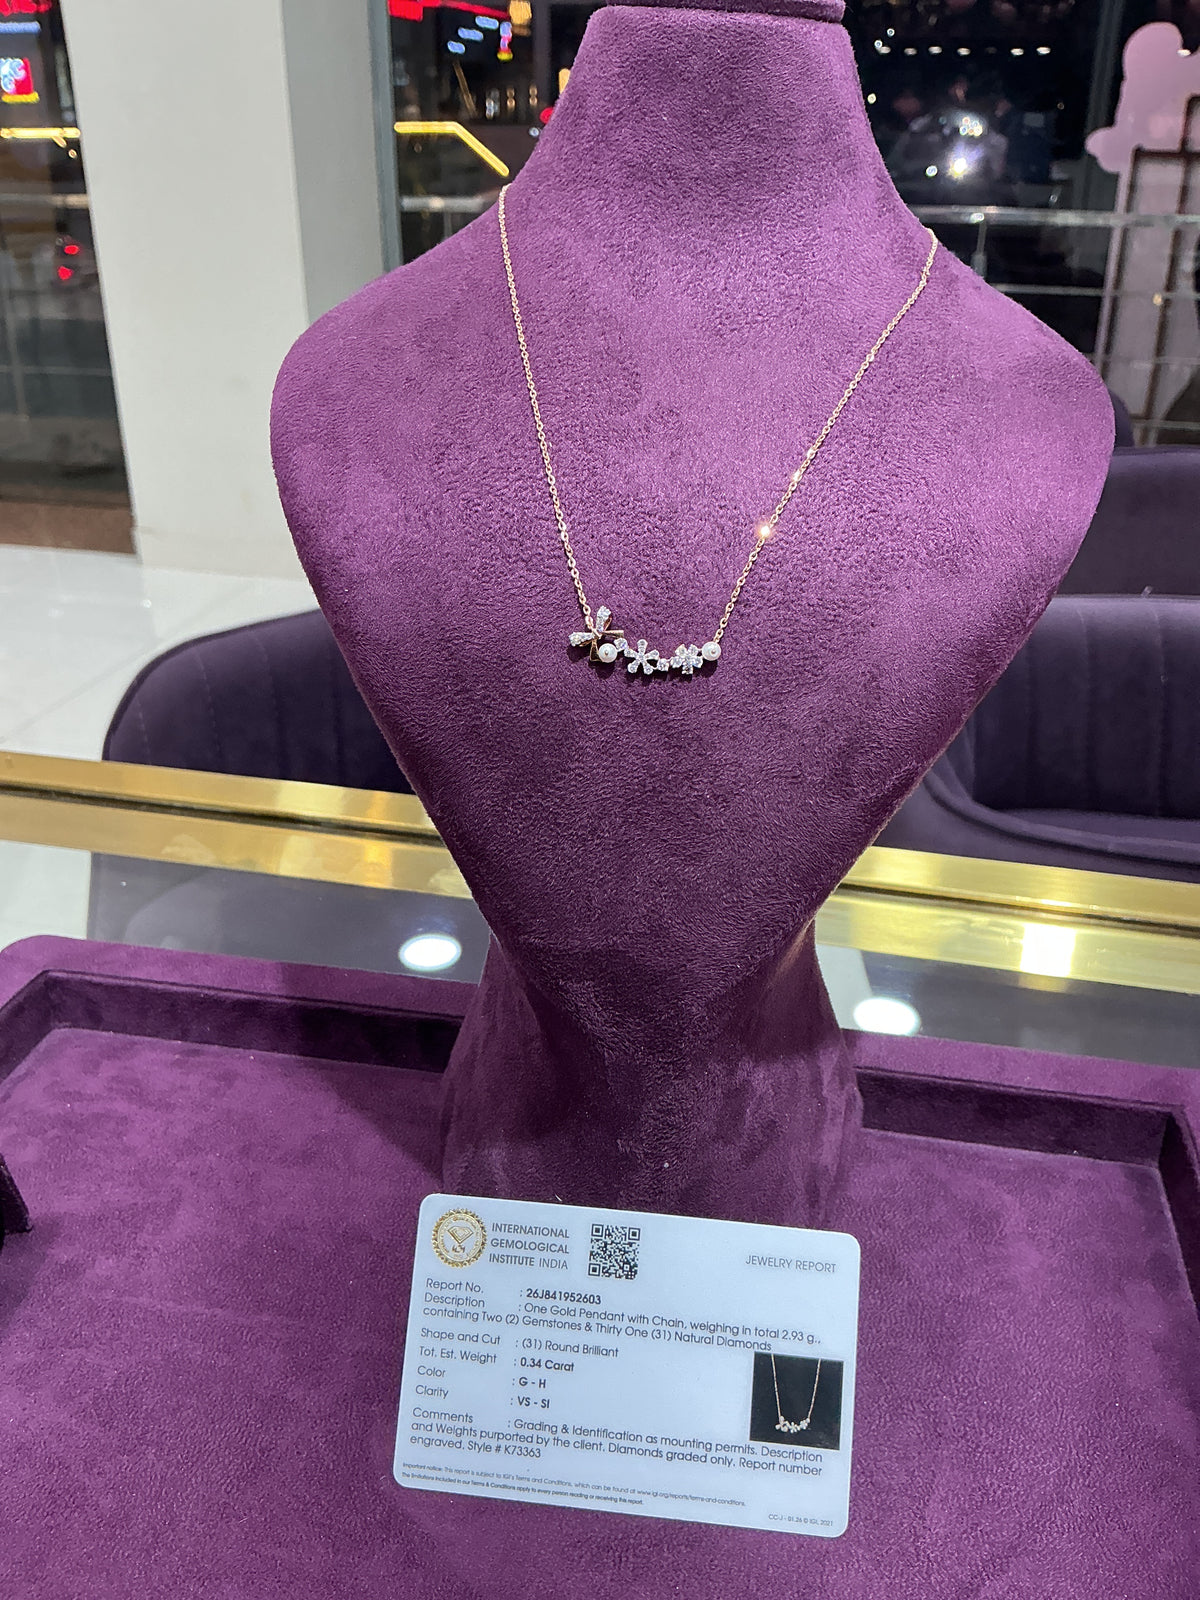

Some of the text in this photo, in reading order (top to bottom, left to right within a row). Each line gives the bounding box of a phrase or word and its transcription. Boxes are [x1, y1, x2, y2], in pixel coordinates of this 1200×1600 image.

[491, 1222, 569, 1238] INTERNATIONAL
[490, 1237, 569, 1254] GEMOLOGICAL
[488, 1253, 568, 1270] INSTITUTE INDIA
[745, 1255, 836, 1273] JEWELRY REPORT
[425, 1277, 463, 1291] Report
[465, 1281, 483, 1293] No.
[526, 1287, 601, 1305] 26J841952603
[422, 1307, 772, 1351] containing Two (2) Gemstones & Thirty One (31) Natural Diamonds
[424, 1291, 485, 1308] Description
[524, 1302, 547, 1316] One
[549, 1305, 576, 1317] Gold
[578, 1307, 625, 1322] Pendant
[627, 1314, 649, 1325] with
[651, 1315, 687, 1329] Chain,
[689, 1320, 739, 1336] weighing
[741, 1324, 751, 1335] in
[754, 1326, 779, 1338] total
[781, 1329, 804, 1341] 2.93
[806, 1334, 821, 1344] g.,
[420, 1327, 454, 1341] Shape
[457, 1332, 479, 1343] and
[481, 1333, 500, 1345] Cut
[521, 1337, 542, 1350] (31)
[544, 1339, 580, 1353] Round
[582, 1343, 619, 1357] Brilliant
[419, 1345, 437, 1357] Tot.
[440, 1347, 456, 1359] Est.
[459, 1350, 497, 1364] Weight
[520, 1356, 542, 1368] 0.34
[544, 1359, 574, 1372] Carat
[417, 1365, 446, 1377] Color
[518, 1376, 528, 1386] G
[538, 1378, 546, 1389] H
[415, 1384, 449, 1399] Clarity
[517, 1395, 531, 1407] VS
[540, 1398, 550, 1408] SI
[409, 1435, 541, 1458] engraved. Style # K73363
[412, 1406, 473, 1423] Comments
[513, 1418, 558, 1435] Grading
[560, 1423, 569, 1434] &
[572, 1425, 642, 1442] Identification
[645, 1435, 658, 1444] as
[660, 1436, 712, 1452] mounting
[714, 1443, 757, 1455] permits.
[761, 1445, 822, 1462] Description
[411, 1422, 822, 1476] and Weights purported by the client. Diamonds graded only. Report number
